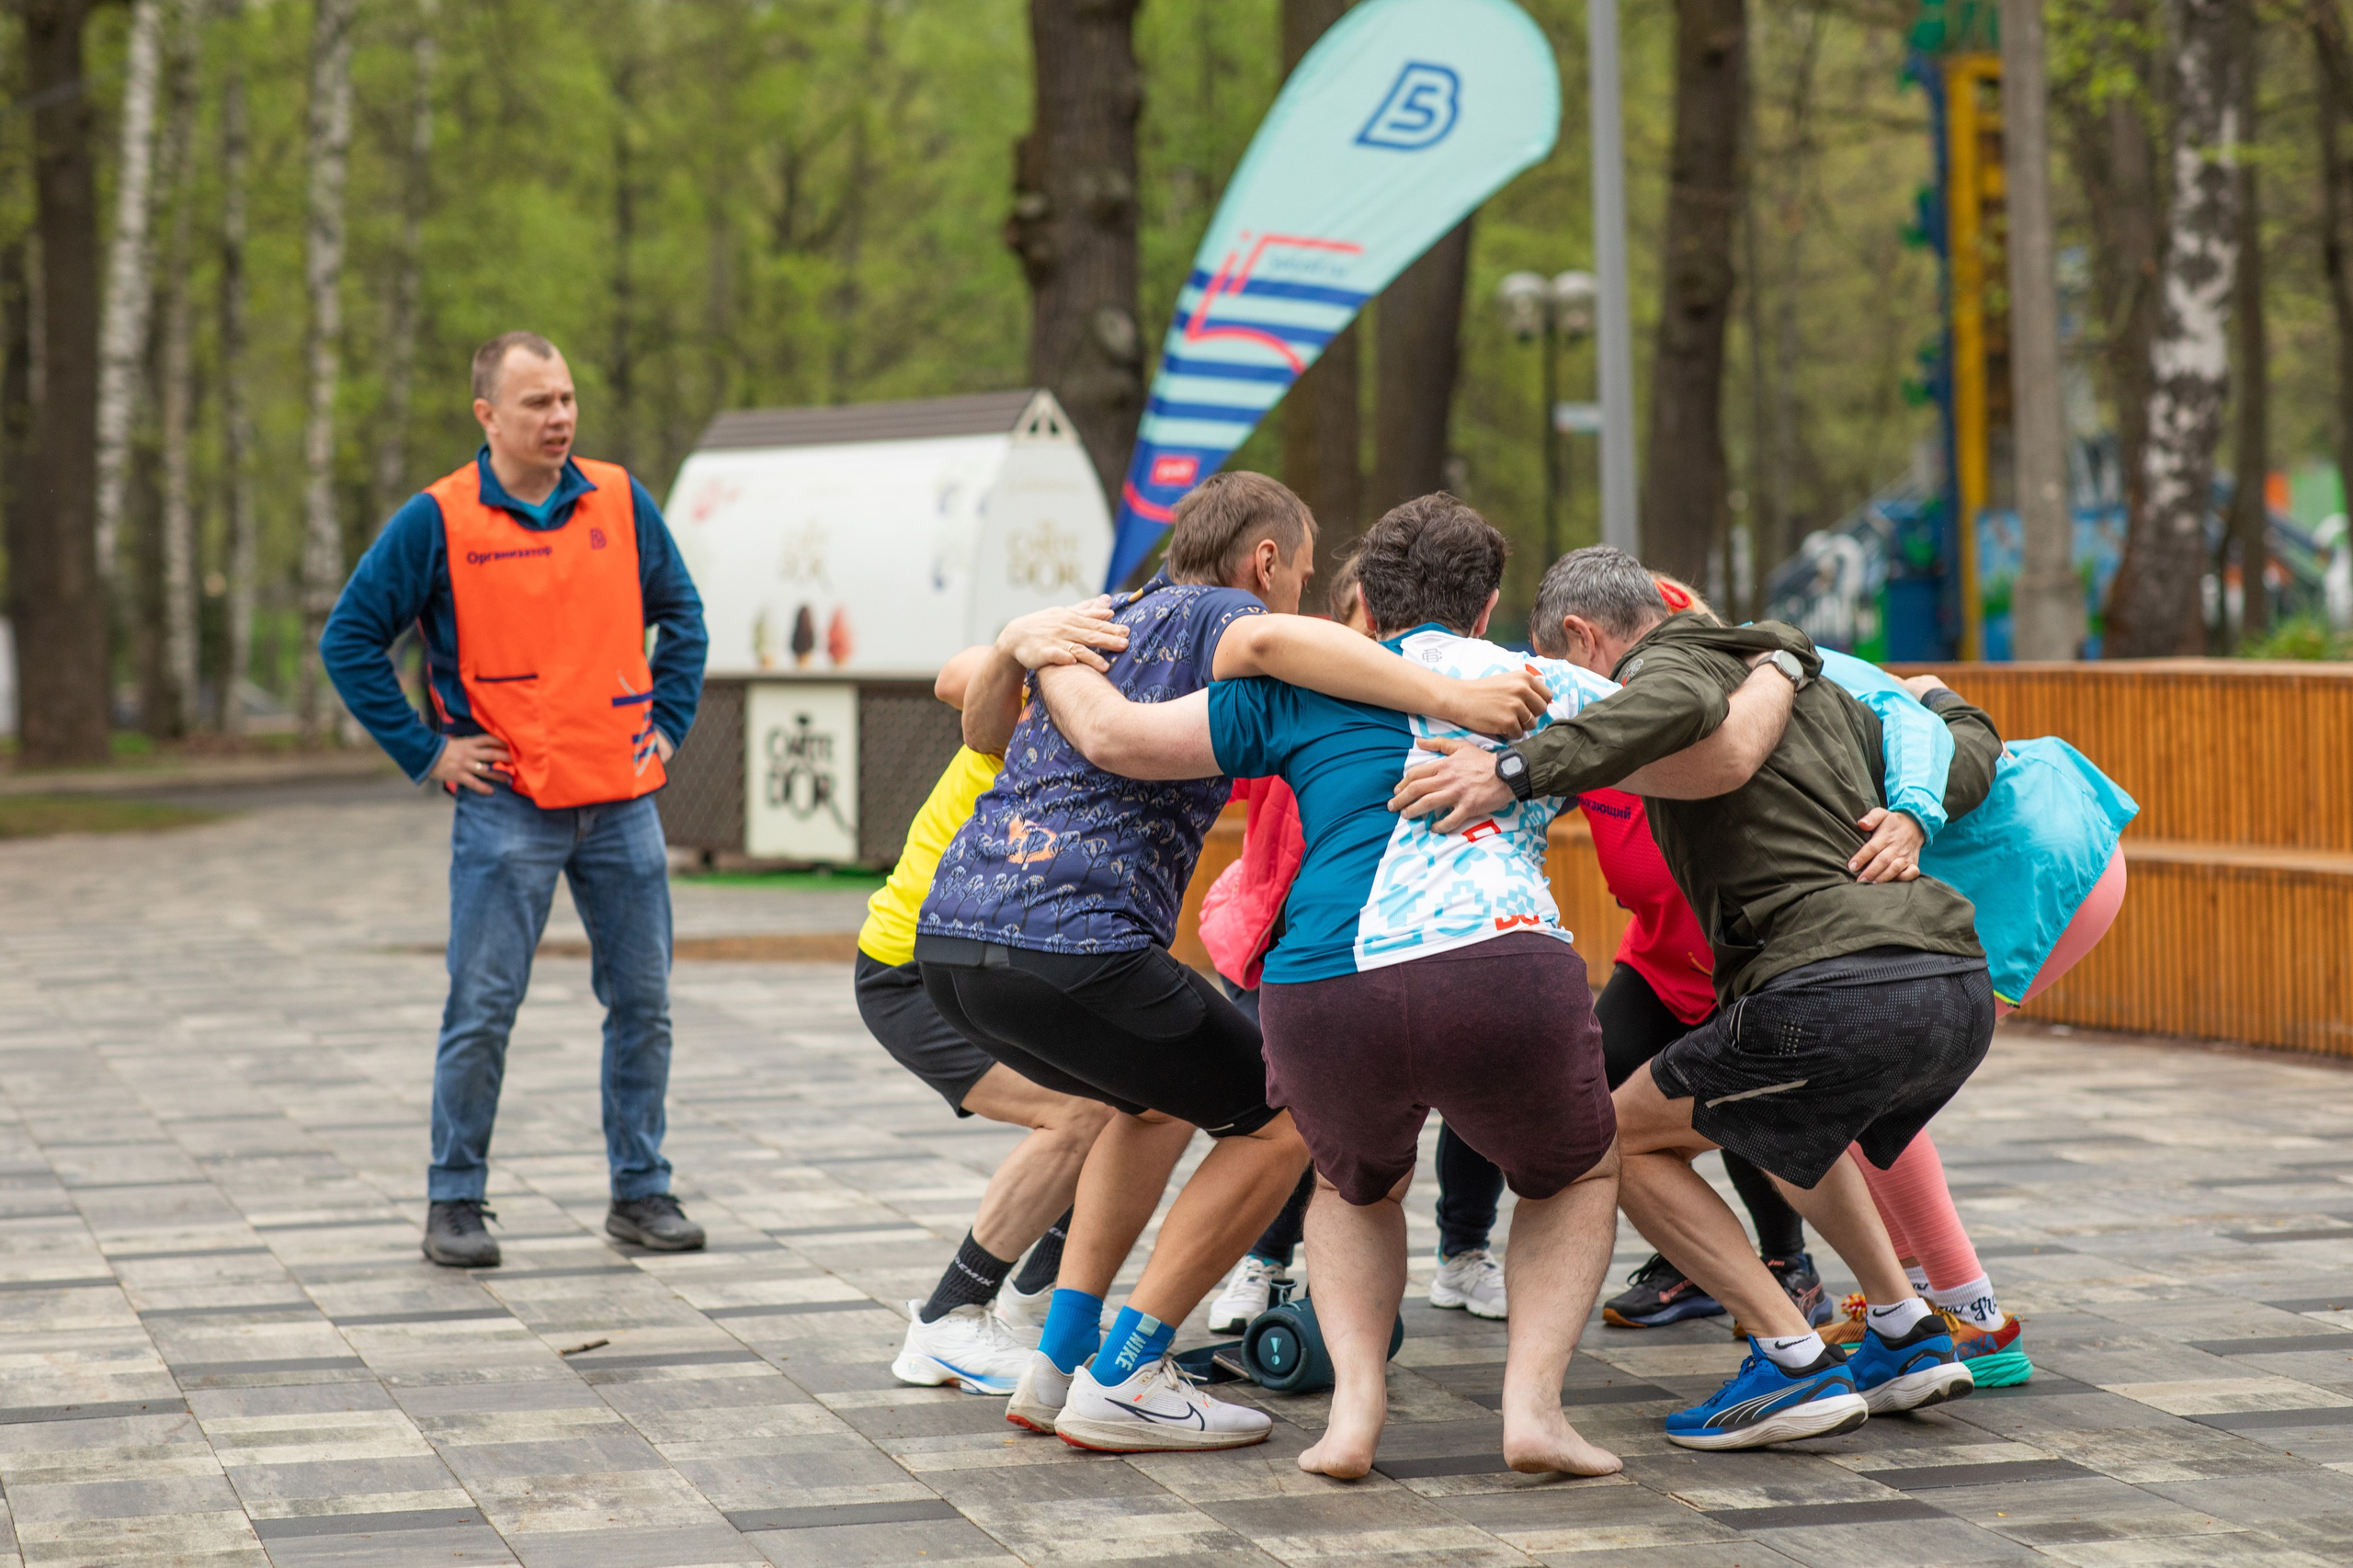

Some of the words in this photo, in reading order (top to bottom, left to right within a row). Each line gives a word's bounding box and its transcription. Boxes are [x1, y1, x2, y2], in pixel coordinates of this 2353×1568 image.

[467, 546, 552, 566] Организатор
[1115, 1332, 1146, 1371] NIKE
[1956, 1333, 1998, 1360] OKA
